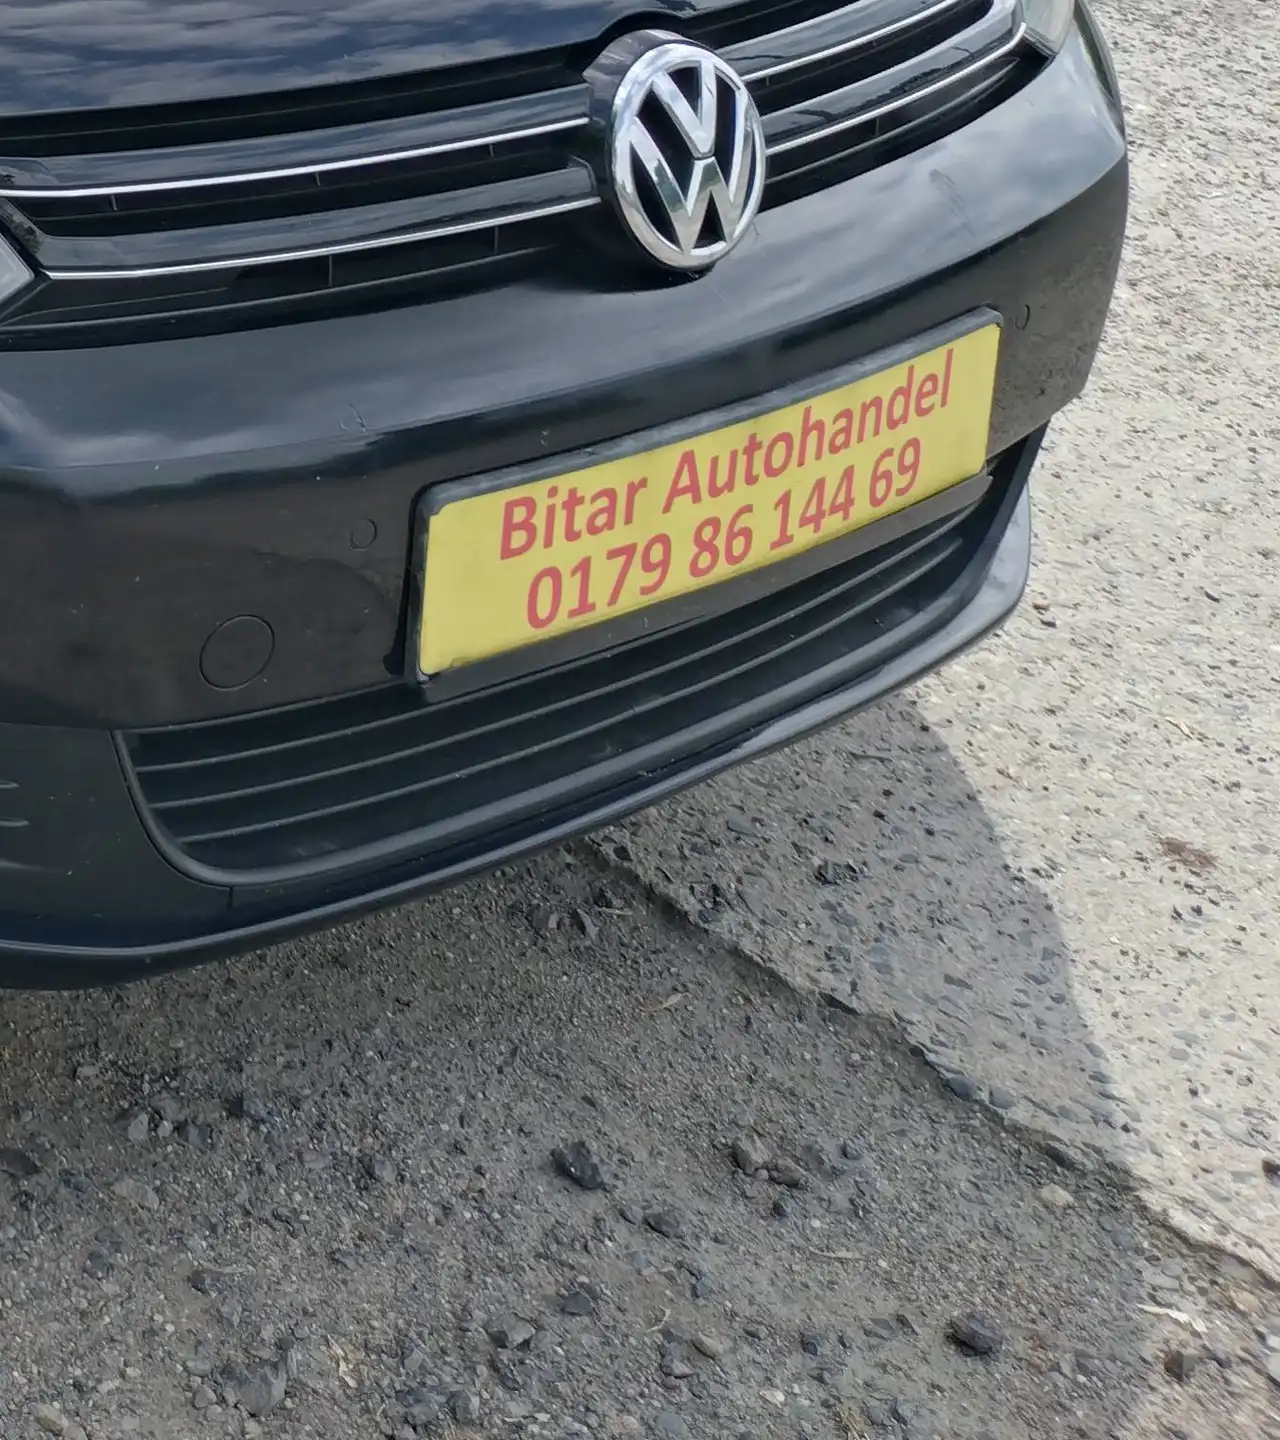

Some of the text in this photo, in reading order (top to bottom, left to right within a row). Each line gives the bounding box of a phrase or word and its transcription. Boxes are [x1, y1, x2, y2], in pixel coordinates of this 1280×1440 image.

[500, 347, 954, 561] Bitar Autohandel
[526, 436, 921, 629] 0179 86 144 69
